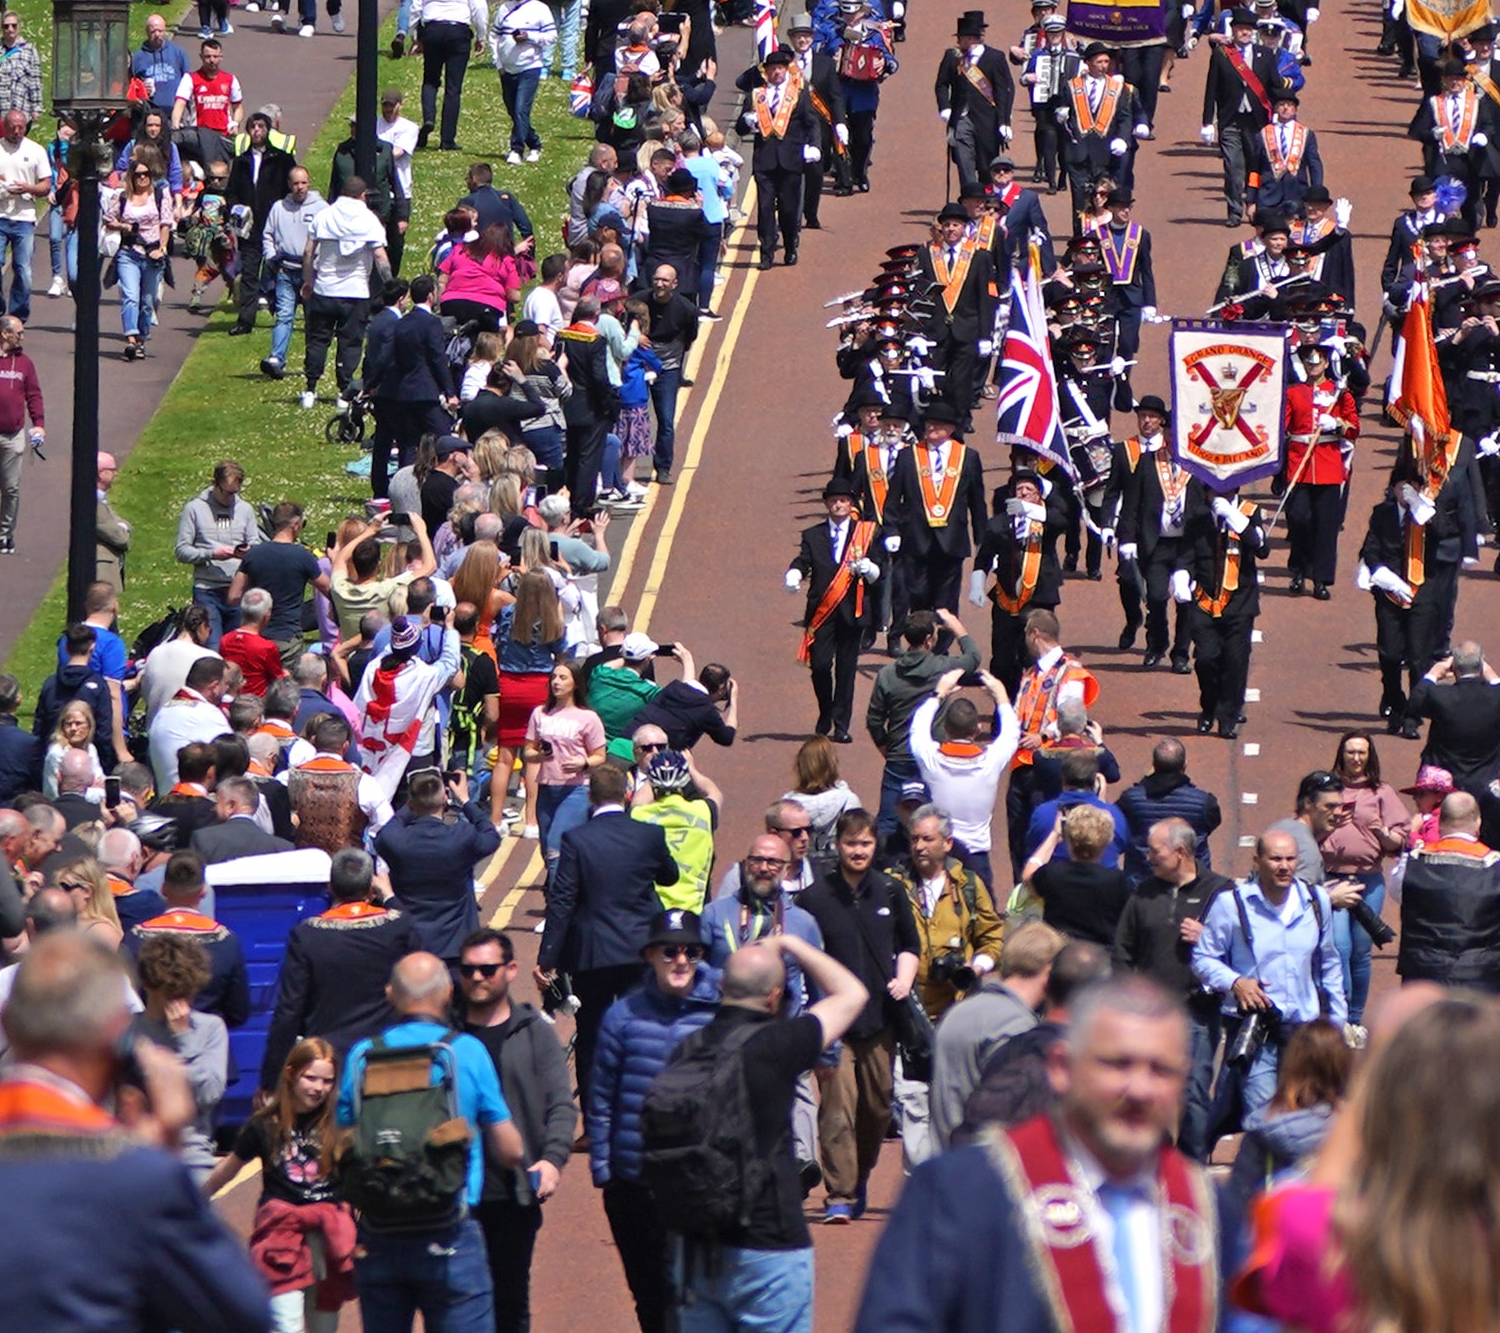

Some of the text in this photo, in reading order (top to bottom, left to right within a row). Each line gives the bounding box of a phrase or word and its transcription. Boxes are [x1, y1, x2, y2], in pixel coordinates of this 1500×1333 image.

[1190, 346, 1270, 366] GRAND ORANGE
[1224, 446, 1264, 464] IRELAND
